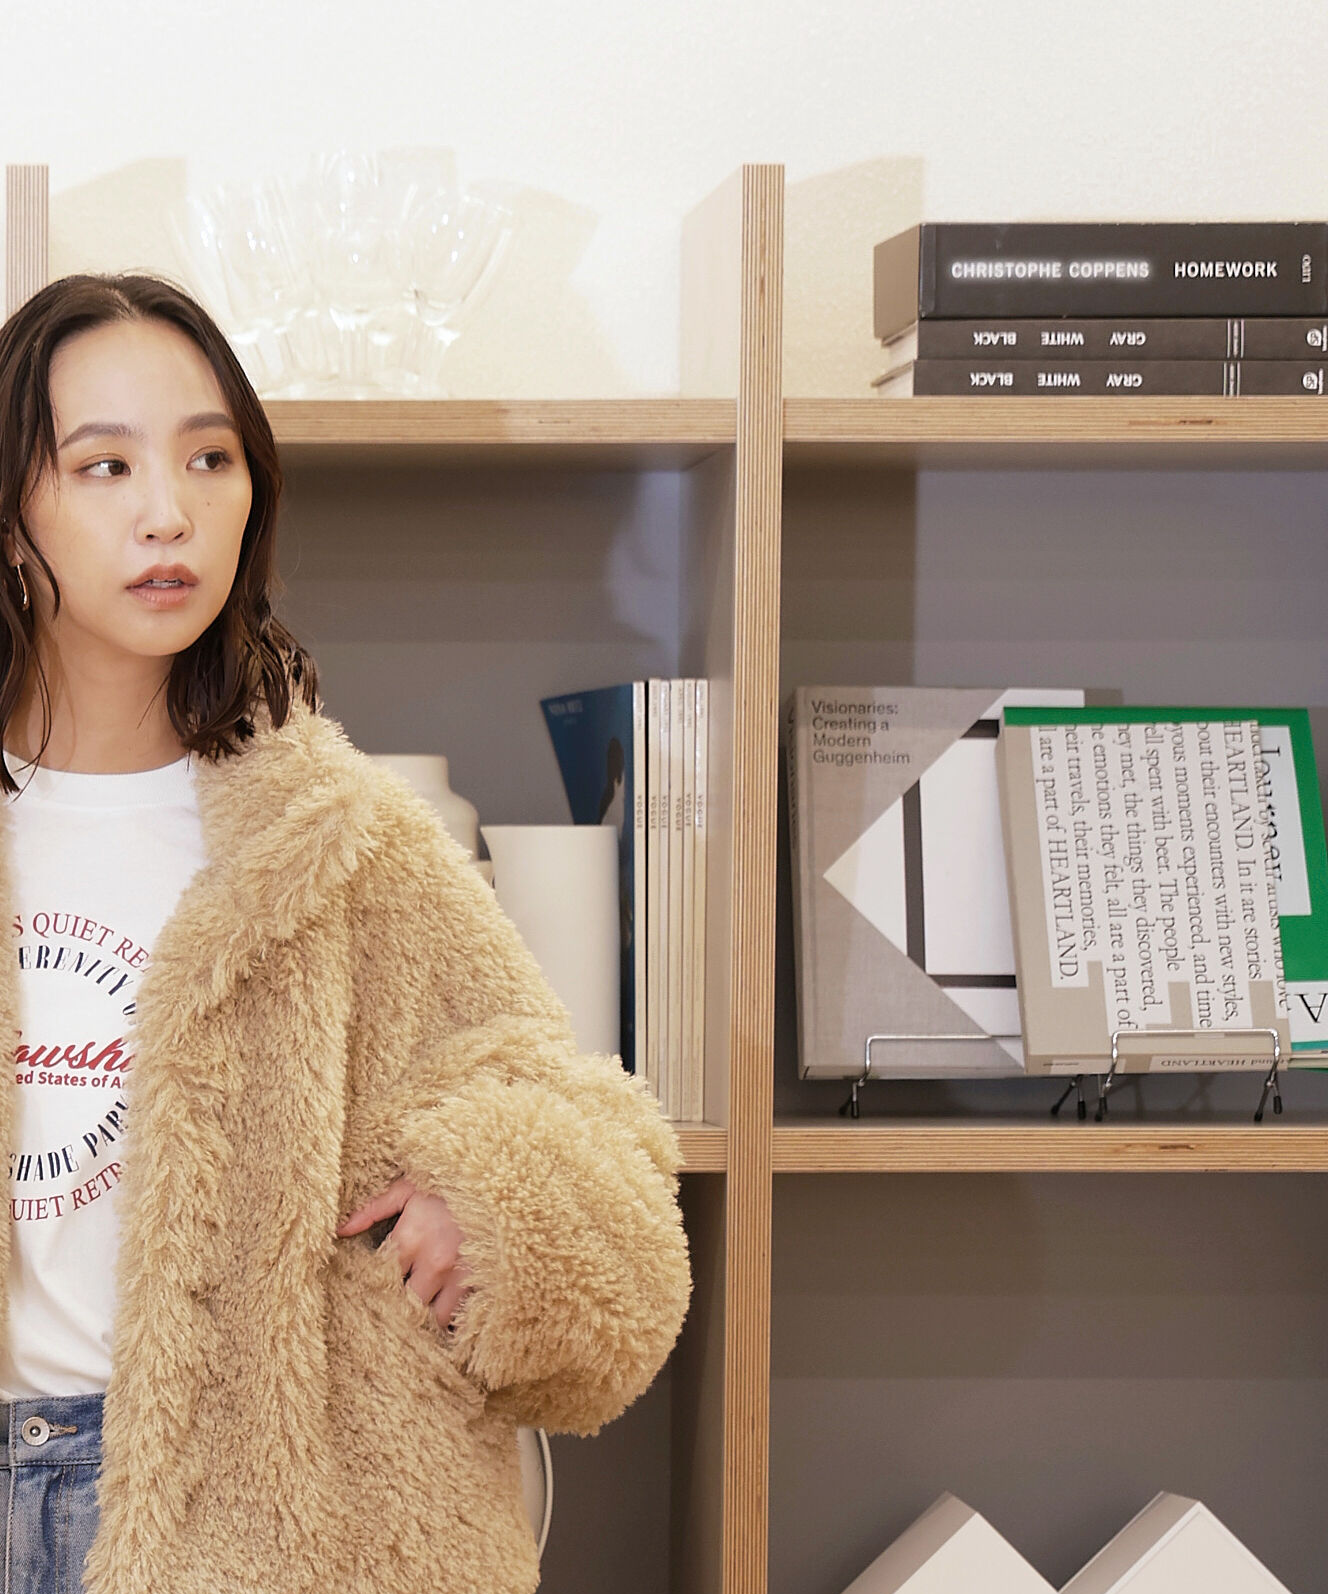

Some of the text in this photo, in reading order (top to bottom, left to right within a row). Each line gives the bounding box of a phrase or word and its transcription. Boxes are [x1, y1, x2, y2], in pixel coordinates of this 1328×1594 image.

[951, 261, 1278, 279] CHRISTOPHE COPPENS HOMEWORK
[973, 332, 1146, 346] GRAY WHITE BLACK
[970, 372, 1143, 387] GRAY WHITE BLACK
[812, 701, 899, 715] Visionaries:
[812, 717, 889, 734] Creating a
[813, 734, 872, 748] Modern
[813, 750, 910, 767] Guggenheim
[1039, 736, 1053, 761] are
[1042, 765, 1054, 774] a
[1093, 743, 1115, 821] emotions
[1120, 753, 1135, 788] met,
[1200, 761, 1221, 799] their
[1036, 777, 1058, 811] part
[1067, 757, 1090, 817] travels,
[1124, 792, 1144, 818] the
[1175, 766, 1194, 843] moments
[1046, 815, 1067, 834] of
[1073, 821, 1093, 860] their
[1096, 824, 1120, 860] they
[1123, 823, 1146, 874] things
[1140, 724, 1185, 972] ell spent with beer. The people
[1205, 802, 1225, 890] encounters
[1102, 863, 1124, 895] felt,
[1237, 859, 1257, 877] In
[1127, 878, 1152, 913] they
[1177, 846, 1211, 951] experienced,
[1240, 882, 1257, 894] it
[1048, 839, 1079, 981] HEARTLAND.
[1076, 863, 1101, 951] memories,
[1107, 898, 1128, 918] all
[1214, 894, 1236, 931] with
[1241, 898, 1256, 924] are
[32, 912, 115, 947] QUIET
[112, 936, 151, 974] RE
[1109, 922, 1124, 949] are
[1218, 935, 1233, 970] new
[18, 945, 134, 996] ERENITY
[1112, 953, 1125, 963] a
[1135, 917, 1164, 1012] discovered,
[1193, 954, 1215, 985] and
[1244, 927, 1267, 980] stories
[1106, 967, 1131, 1004] part
[1216, 974, 1244, 1021] styles,
[1117, 1008, 1139, 1030] of
[1196, 989, 1216, 1028] time
[15, 1070, 126, 1089] ed States of A
[1160, 1059, 1246, 1067] HEARTLAND
[8, 1194, 65, 1223] UIET
